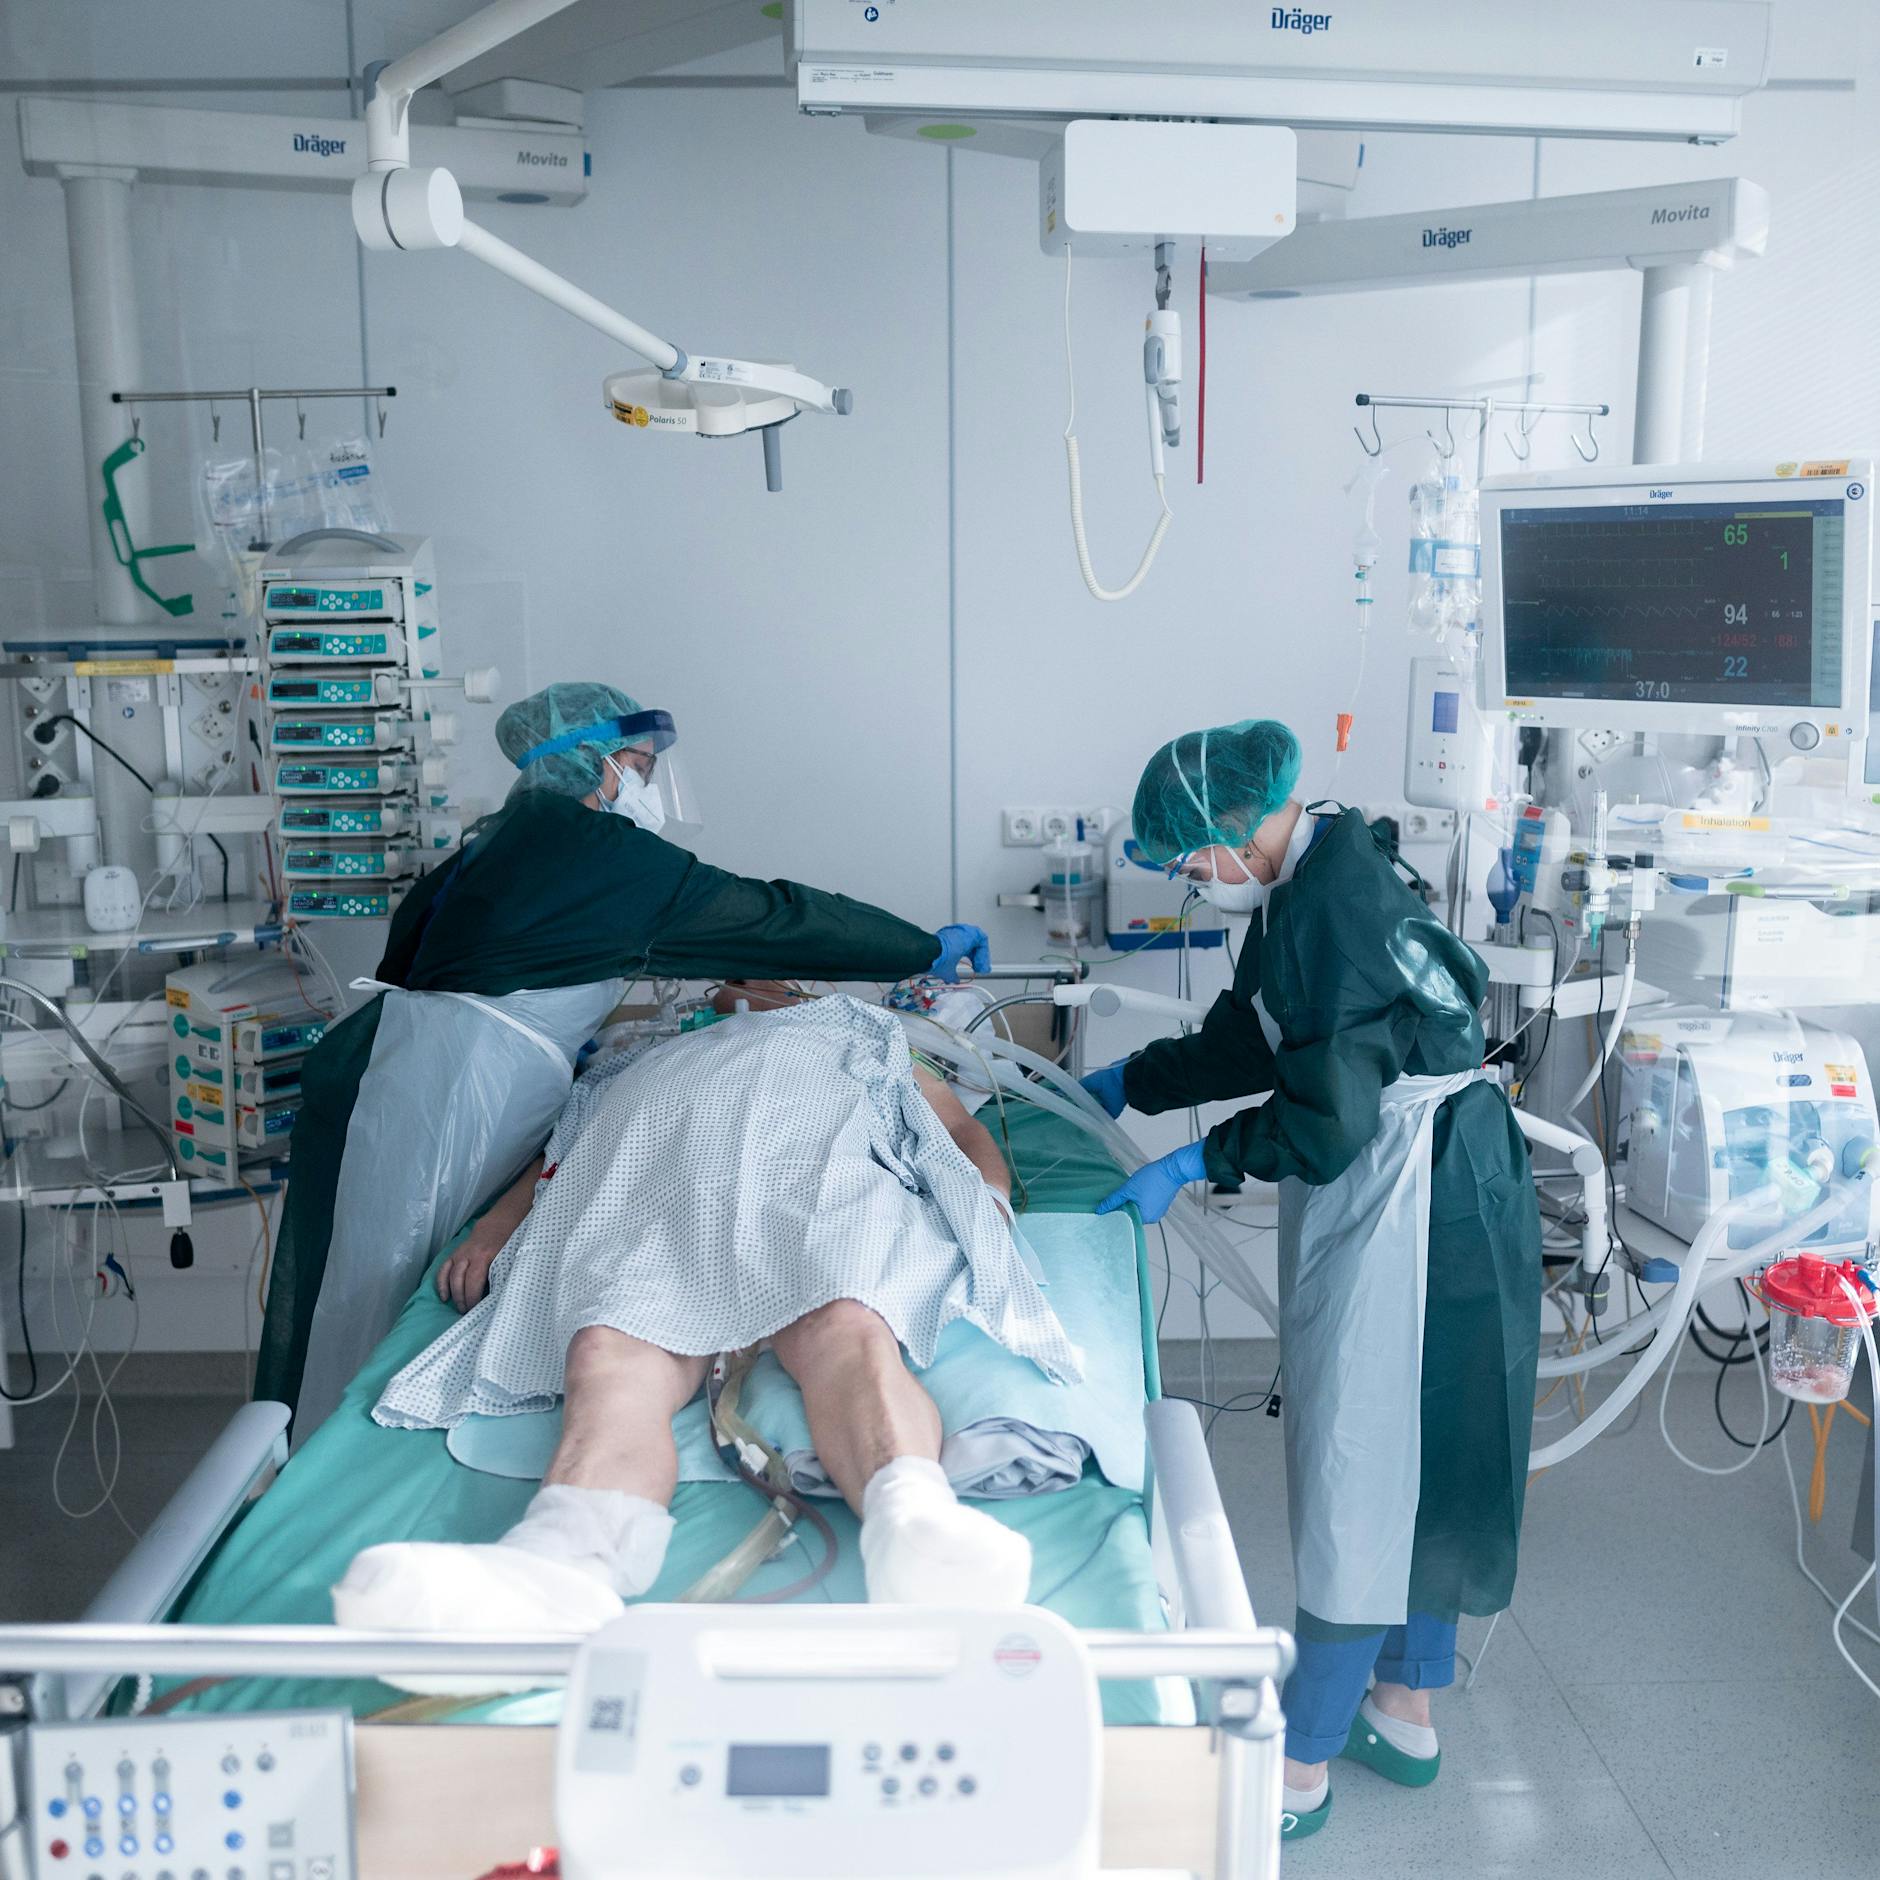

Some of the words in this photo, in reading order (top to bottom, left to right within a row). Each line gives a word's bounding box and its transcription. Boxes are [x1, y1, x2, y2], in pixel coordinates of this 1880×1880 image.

[1271, 7, 1333, 34] Dräger
[293, 133, 347, 157] Dräger
[516, 151, 568, 167] Movita
[1651, 204, 1711, 225] Movita
[1422, 227, 1473, 249] Dräger
[649, 414, 676, 425] Polaris
[677, 416, 687, 425] 50
[1649, 489, 1673, 500] Dräger
[1724, 523, 1749, 546] 65
[1780, 551, 1789, 571] 1
[1724, 603, 1749, 625] 94
[1723, 656, 1748, 677] 22
[1735, 724, 1761, 734] Infinity
[1701, 815, 1752, 829] Inhalation
[1772, 1051, 1804, 1065] Dräger
